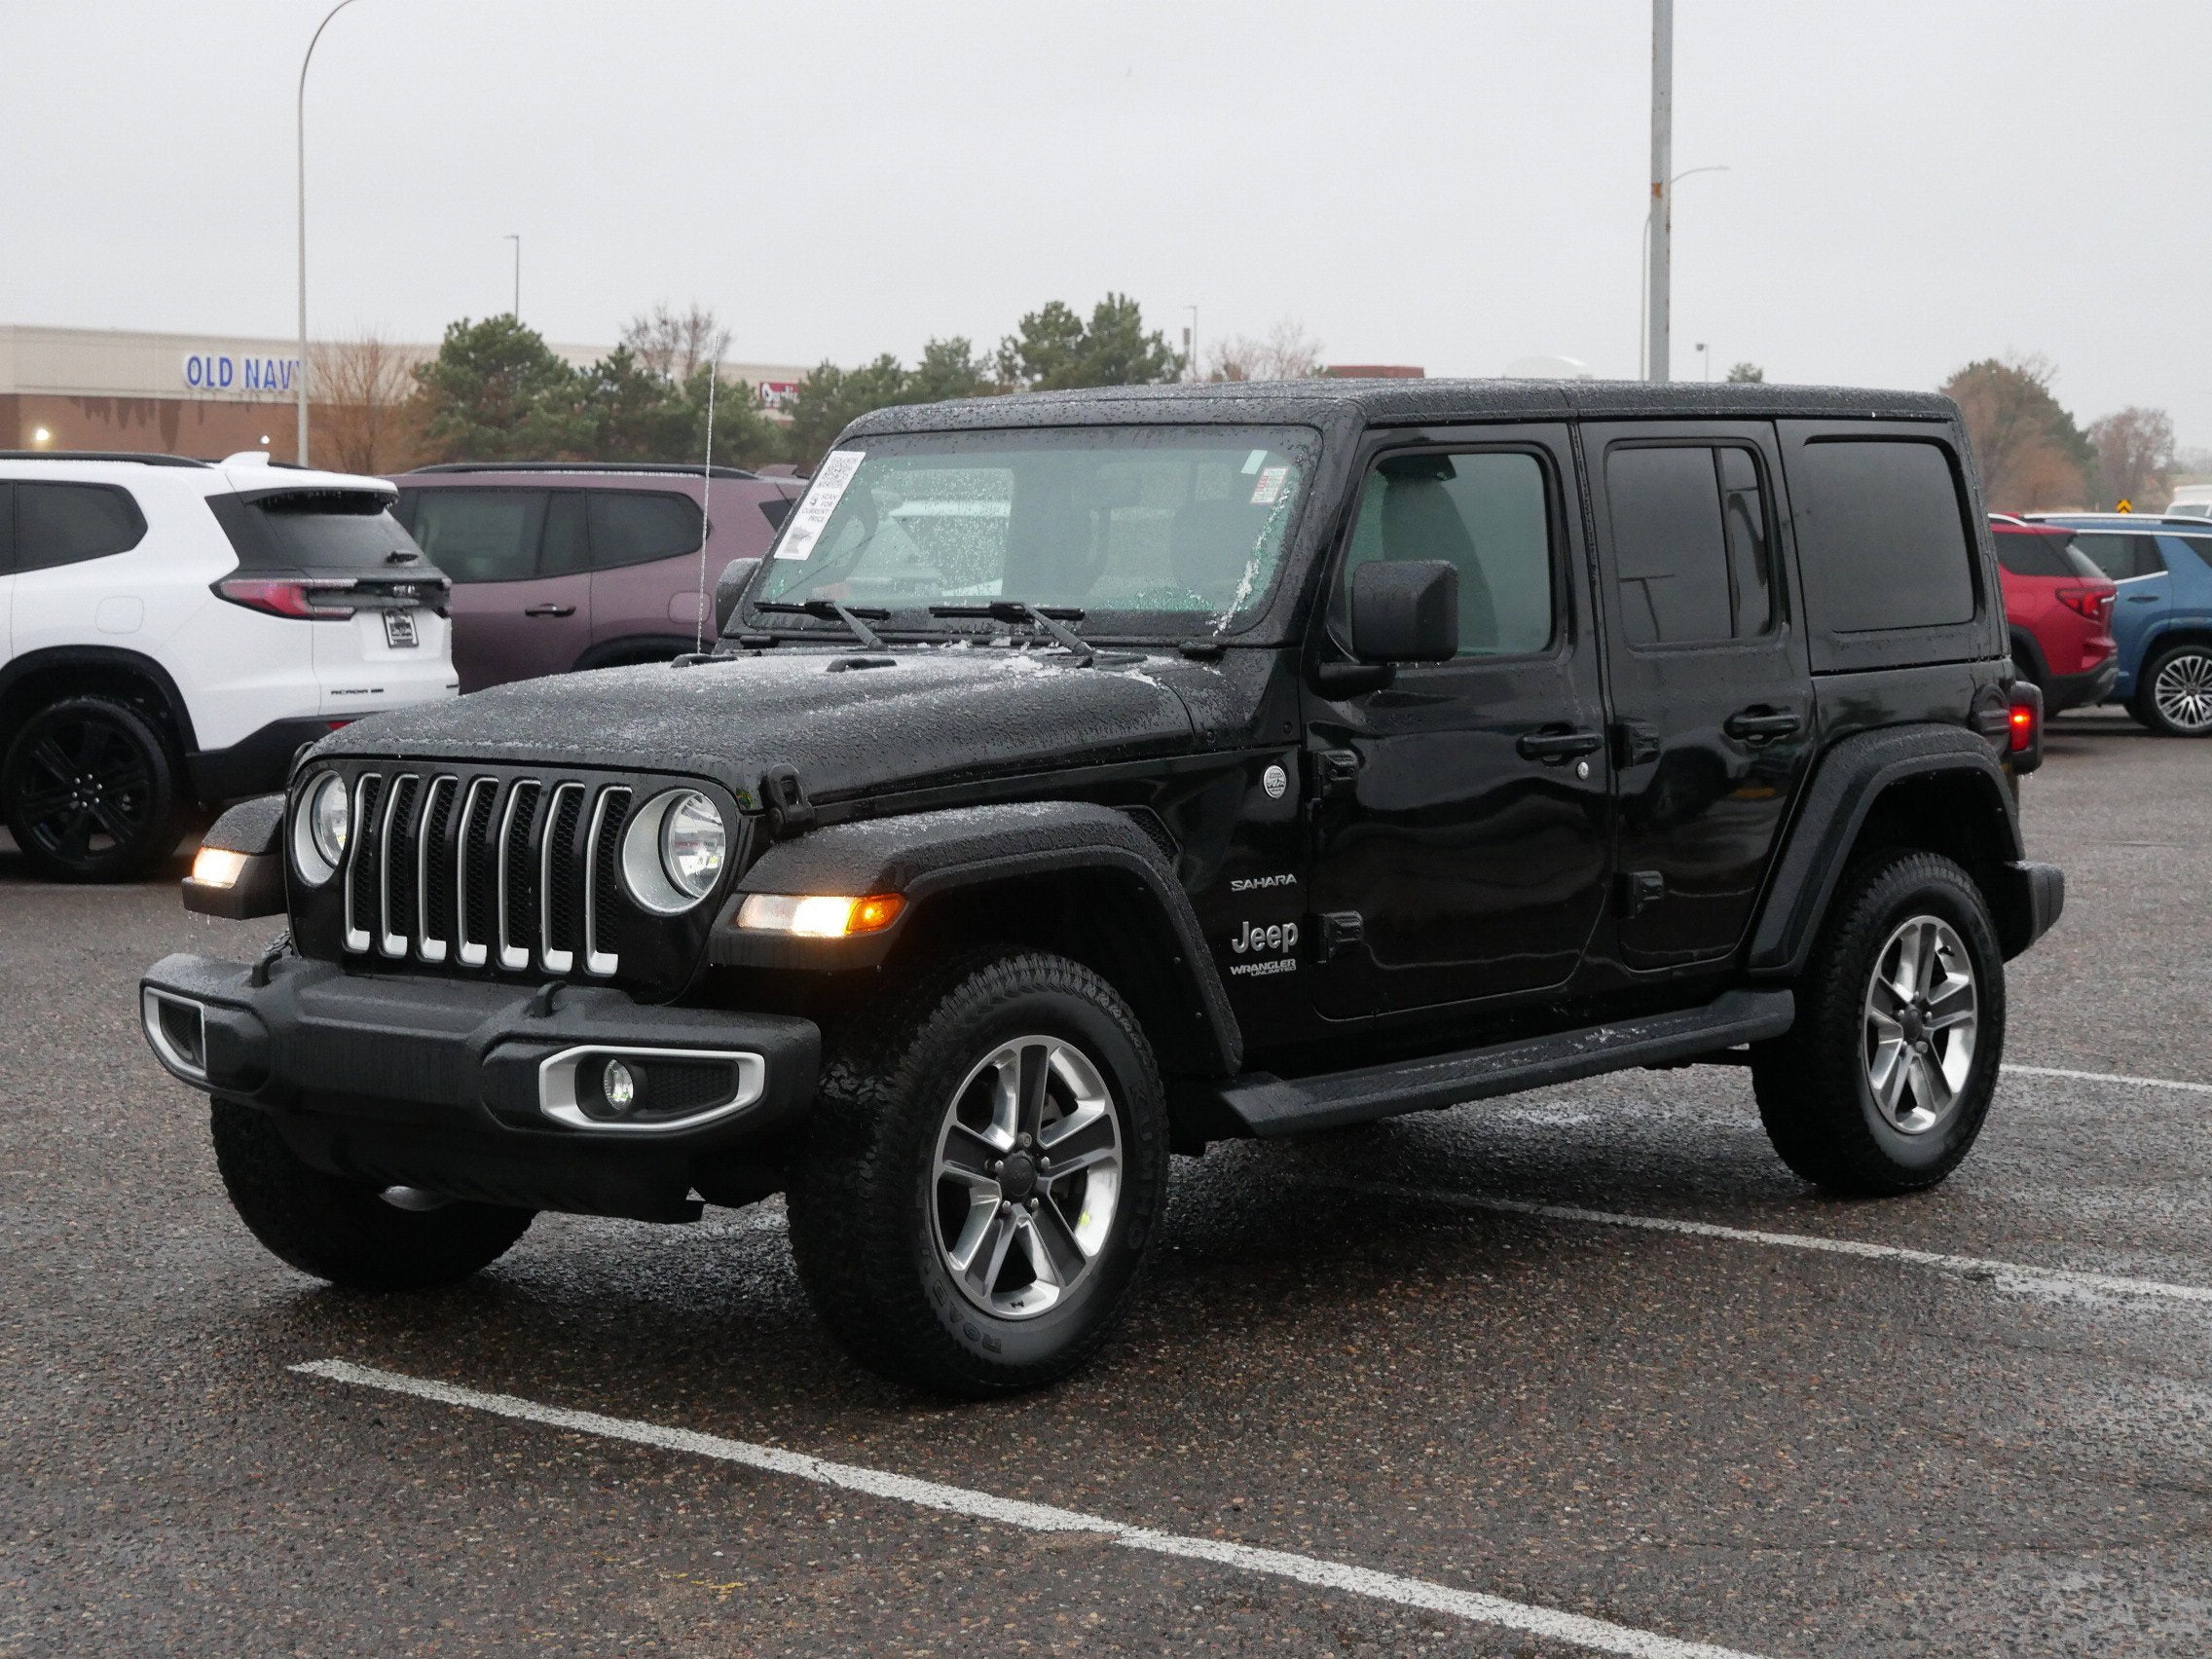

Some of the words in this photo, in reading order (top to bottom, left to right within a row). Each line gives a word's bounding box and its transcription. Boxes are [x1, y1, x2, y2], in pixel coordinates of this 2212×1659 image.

[187, 356, 233, 387] OLD
[1230, 873, 1298, 892] SAHARA
[1231, 921, 1299, 954] Jeep
[1230, 958, 1296, 976] WRANGLER
